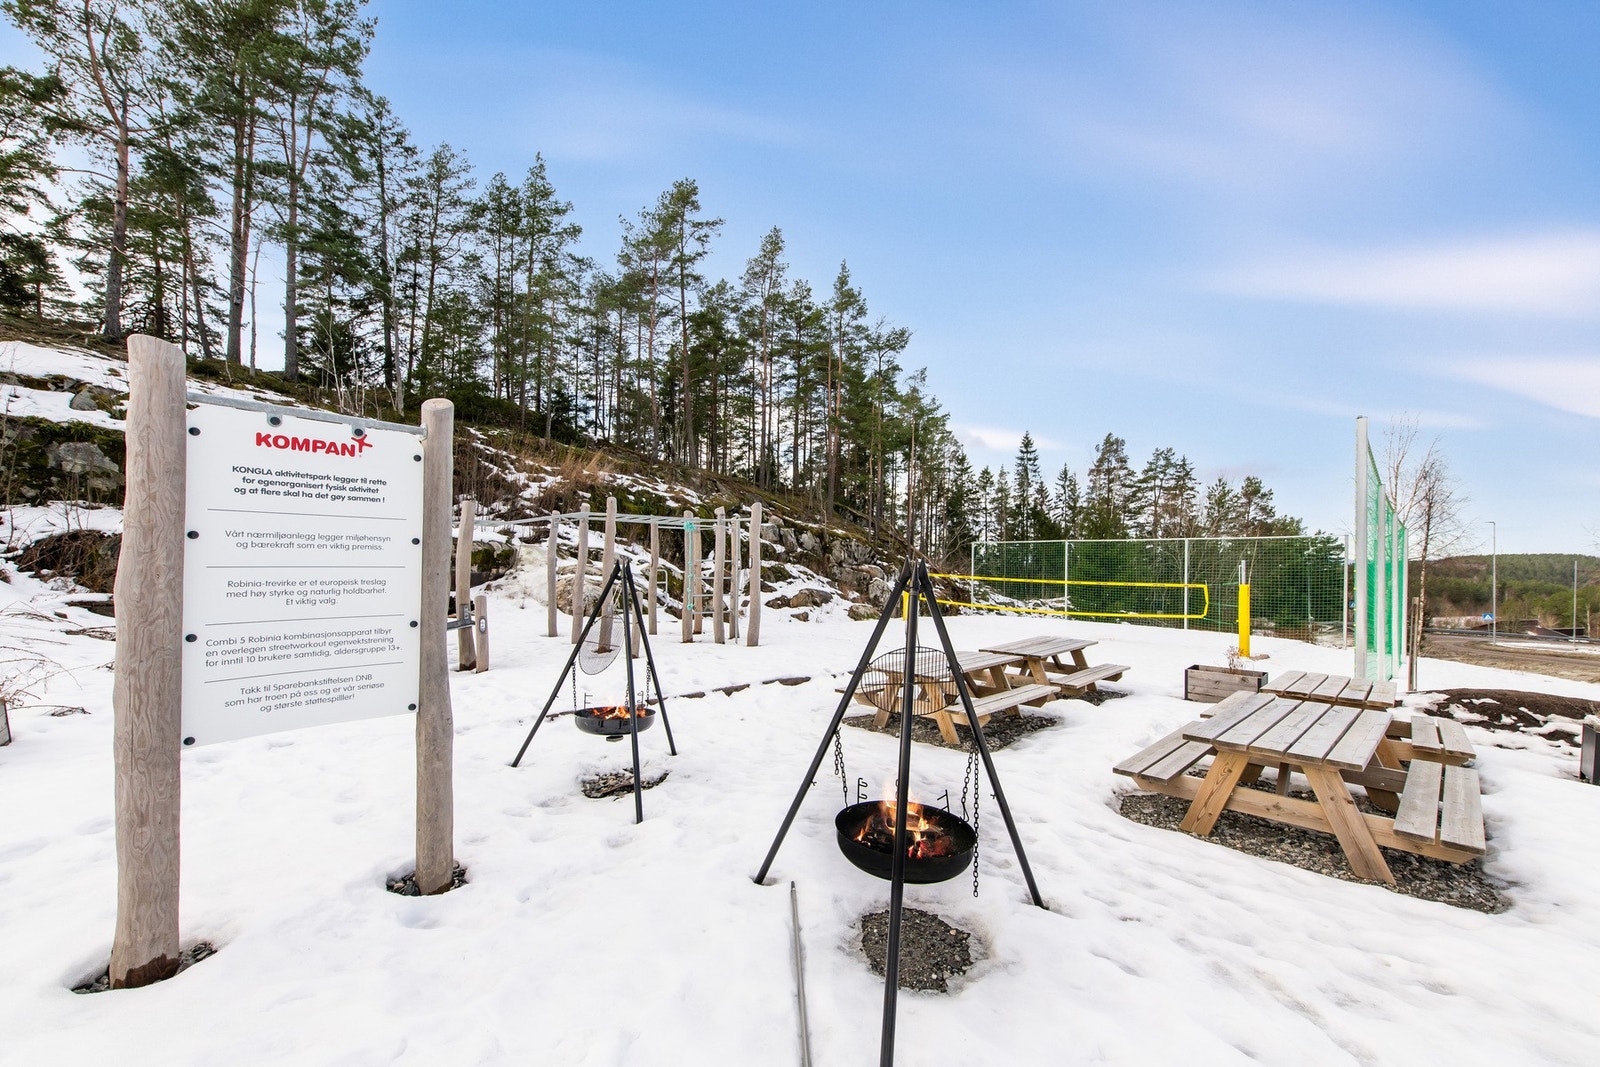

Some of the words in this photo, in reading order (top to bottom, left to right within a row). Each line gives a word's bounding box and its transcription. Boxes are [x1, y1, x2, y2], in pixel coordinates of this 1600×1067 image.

[256, 432, 356, 457] KOMPAN
[232, 465, 273, 476] KONGLA
[275, 470, 332, 481] aktivitetspark
[333, 474, 359, 484] legger
[241, 476, 255, 484] for
[257, 479, 323, 490] egenorganisert
[325, 482, 347, 492] fysisk
[349, 486, 379, 494] aktivitet
[260, 488, 281, 496] flere
[283, 488, 300, 497] skal
[246, 532, 316, 541] nærmiljøanlegg
[317, 533, 344, 542] legger
[345, 534, 391, 543] miljøhensyn
[250, 540, 295, 549] bærekraft
[329, 543, 350, 551] viktig
[227, 579, 297, 588] Robinia-trevirke
[319, 579, 359, 587] europeisk
[360, 579, 387, 587] treslag
[250, 590, 267, 598] høy
[269, 589, 295, 598] styrke
[310, 589, 341, 597] naturlig
[205, 638, 237, 647] Combi
[248, 634, 281, 644] Robinia
[283, 629, 372, 640] kombinasjonsapparat
[220, 646, 266, 656] overlegen
[269, 641, 326, 652] streetworkout
[328, 637, 394, 647] egenvektstrening
[205, 659, 219, 667] for
[221, 656, 244, 666] inntil
[258, 653, 292, 662] brukere
[294, 650, 332, 658] samtidig,
[334, 646, 386, 655] aldersgruppe
[240, 686, 262, 695] Takk
[272, 677, 354, 691] Sparebankstiftelsen
[224, 699, 245, 707] som
[290, 691, 301, 699] på
[274, 700, 303, 709] største
